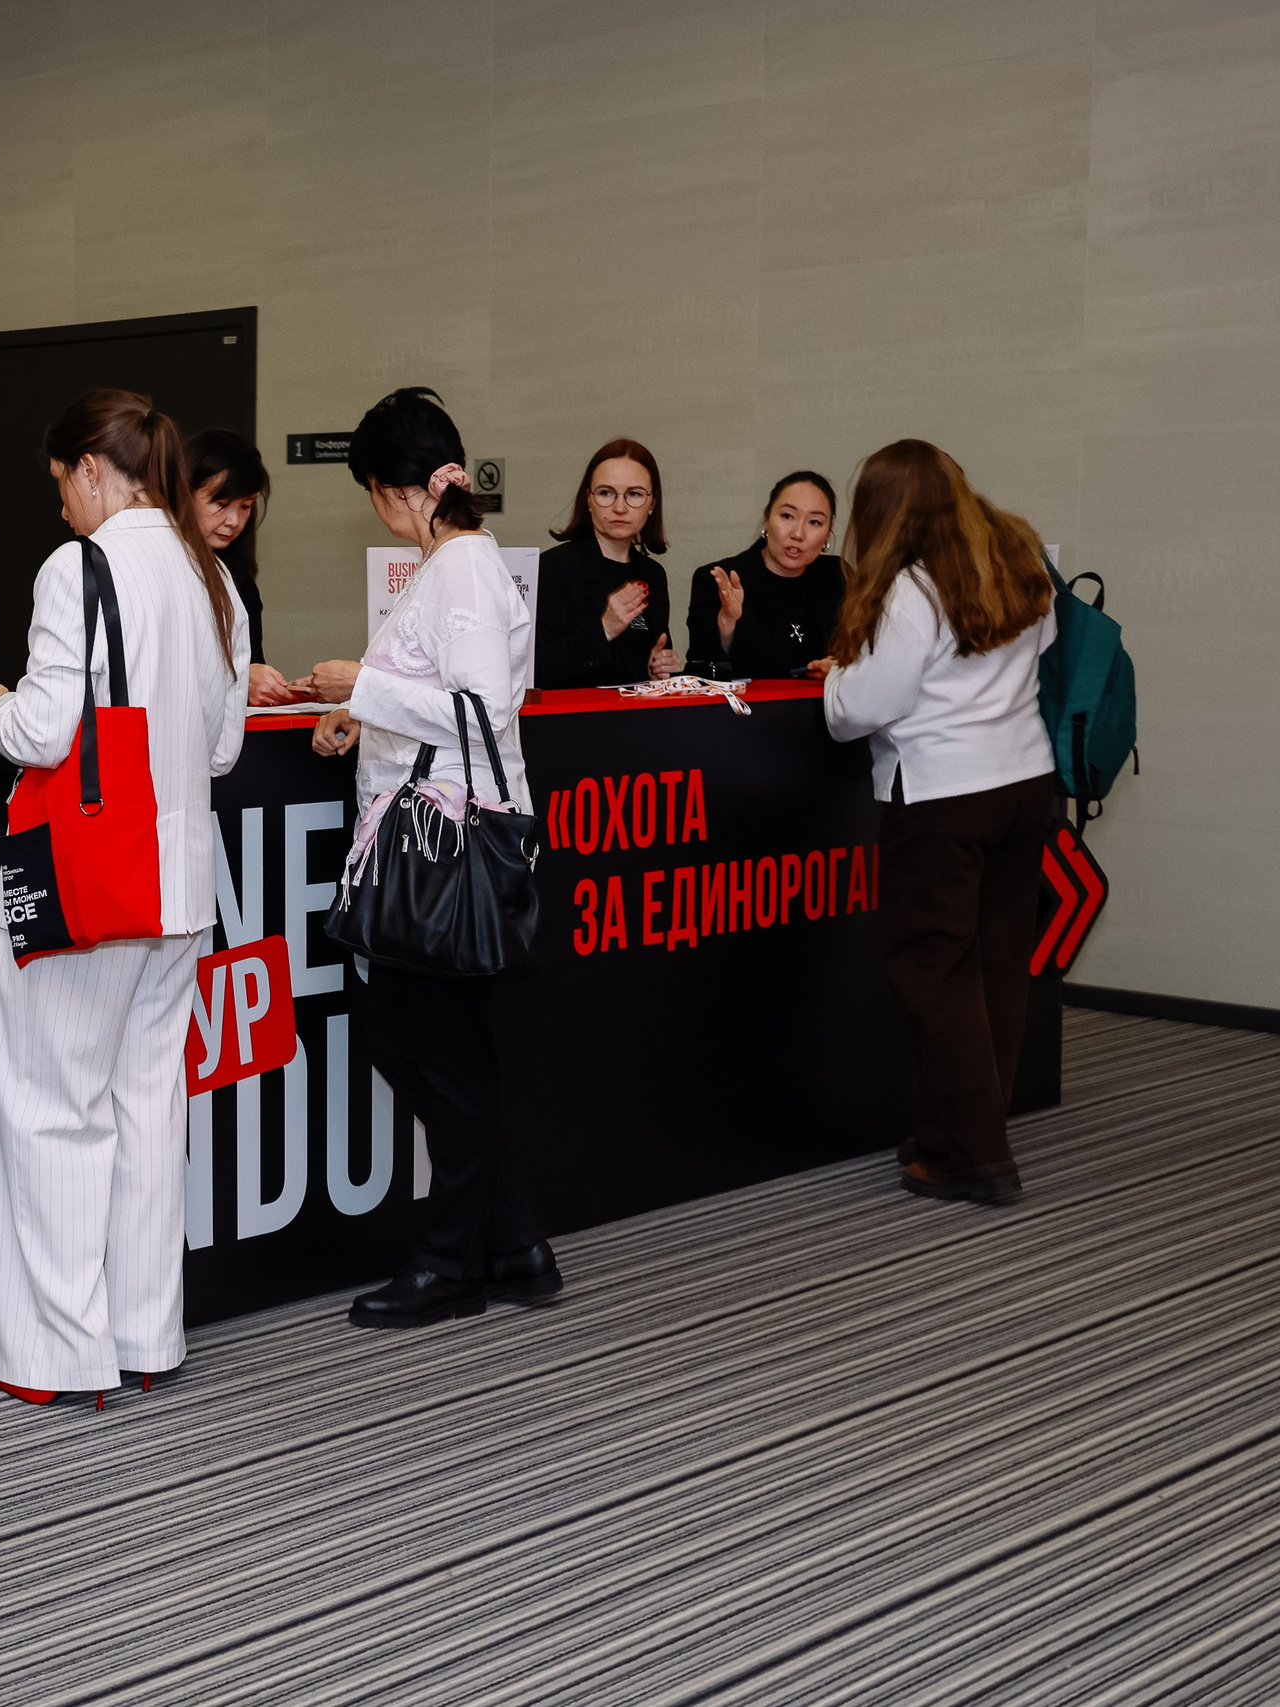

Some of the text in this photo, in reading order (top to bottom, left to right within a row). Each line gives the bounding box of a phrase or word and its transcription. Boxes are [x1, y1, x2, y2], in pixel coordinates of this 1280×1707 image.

[295, 441, 303, 457] 1
[315, 440, 351, 450] Конферен
[388, 562, 418, 577] BUSIN
[547, 768, 708, 855] «ОХОТА
[3, 885, 28, 898] МЕСТЕ
[4, 889, 48, 906] Ы МОЖЕМ
[573, 844, 879, 956] ЗА ЕДИНОРОГА
[192, 956, 271, 1080] УР
